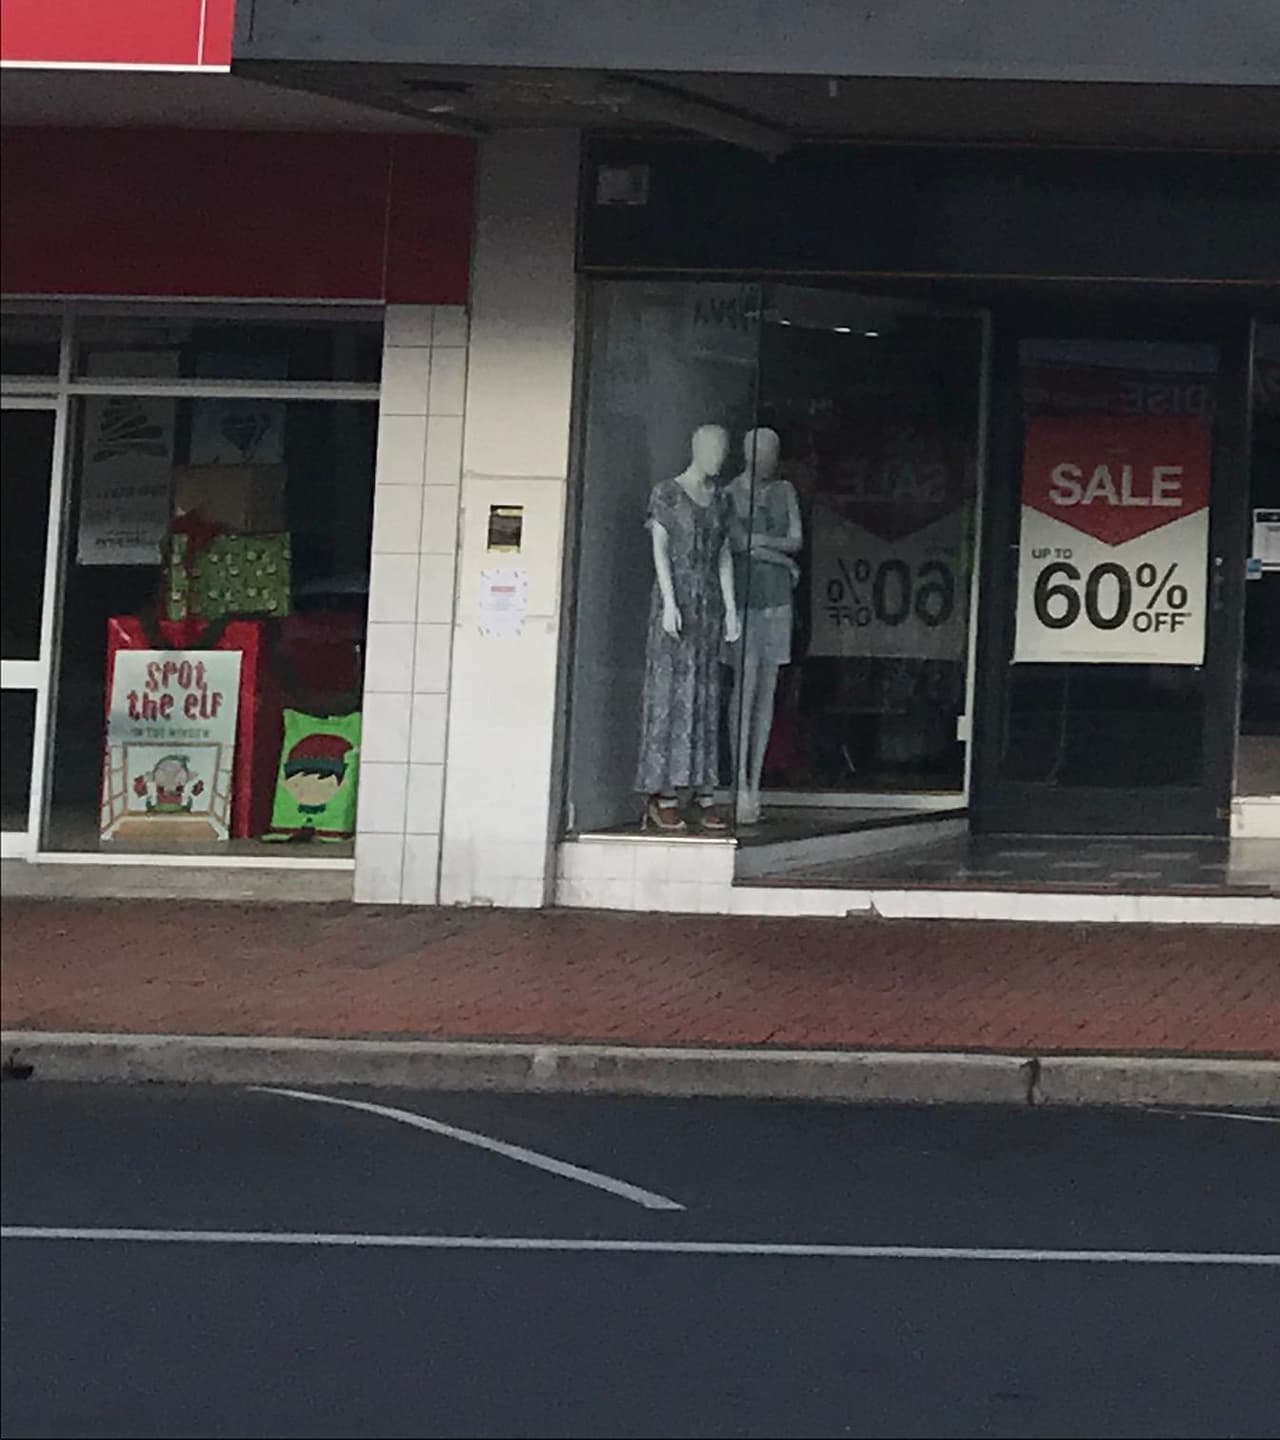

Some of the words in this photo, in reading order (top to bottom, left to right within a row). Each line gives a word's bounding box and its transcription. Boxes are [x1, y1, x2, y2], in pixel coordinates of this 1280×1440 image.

[1049, 462, 1184, 507] SALE
[1031, 548, 1051, 560] UP
[1055, 548, 1074, 560] TO
[1033, 561, 1189, 631] 60%
[127, 690, 174, 720] the
